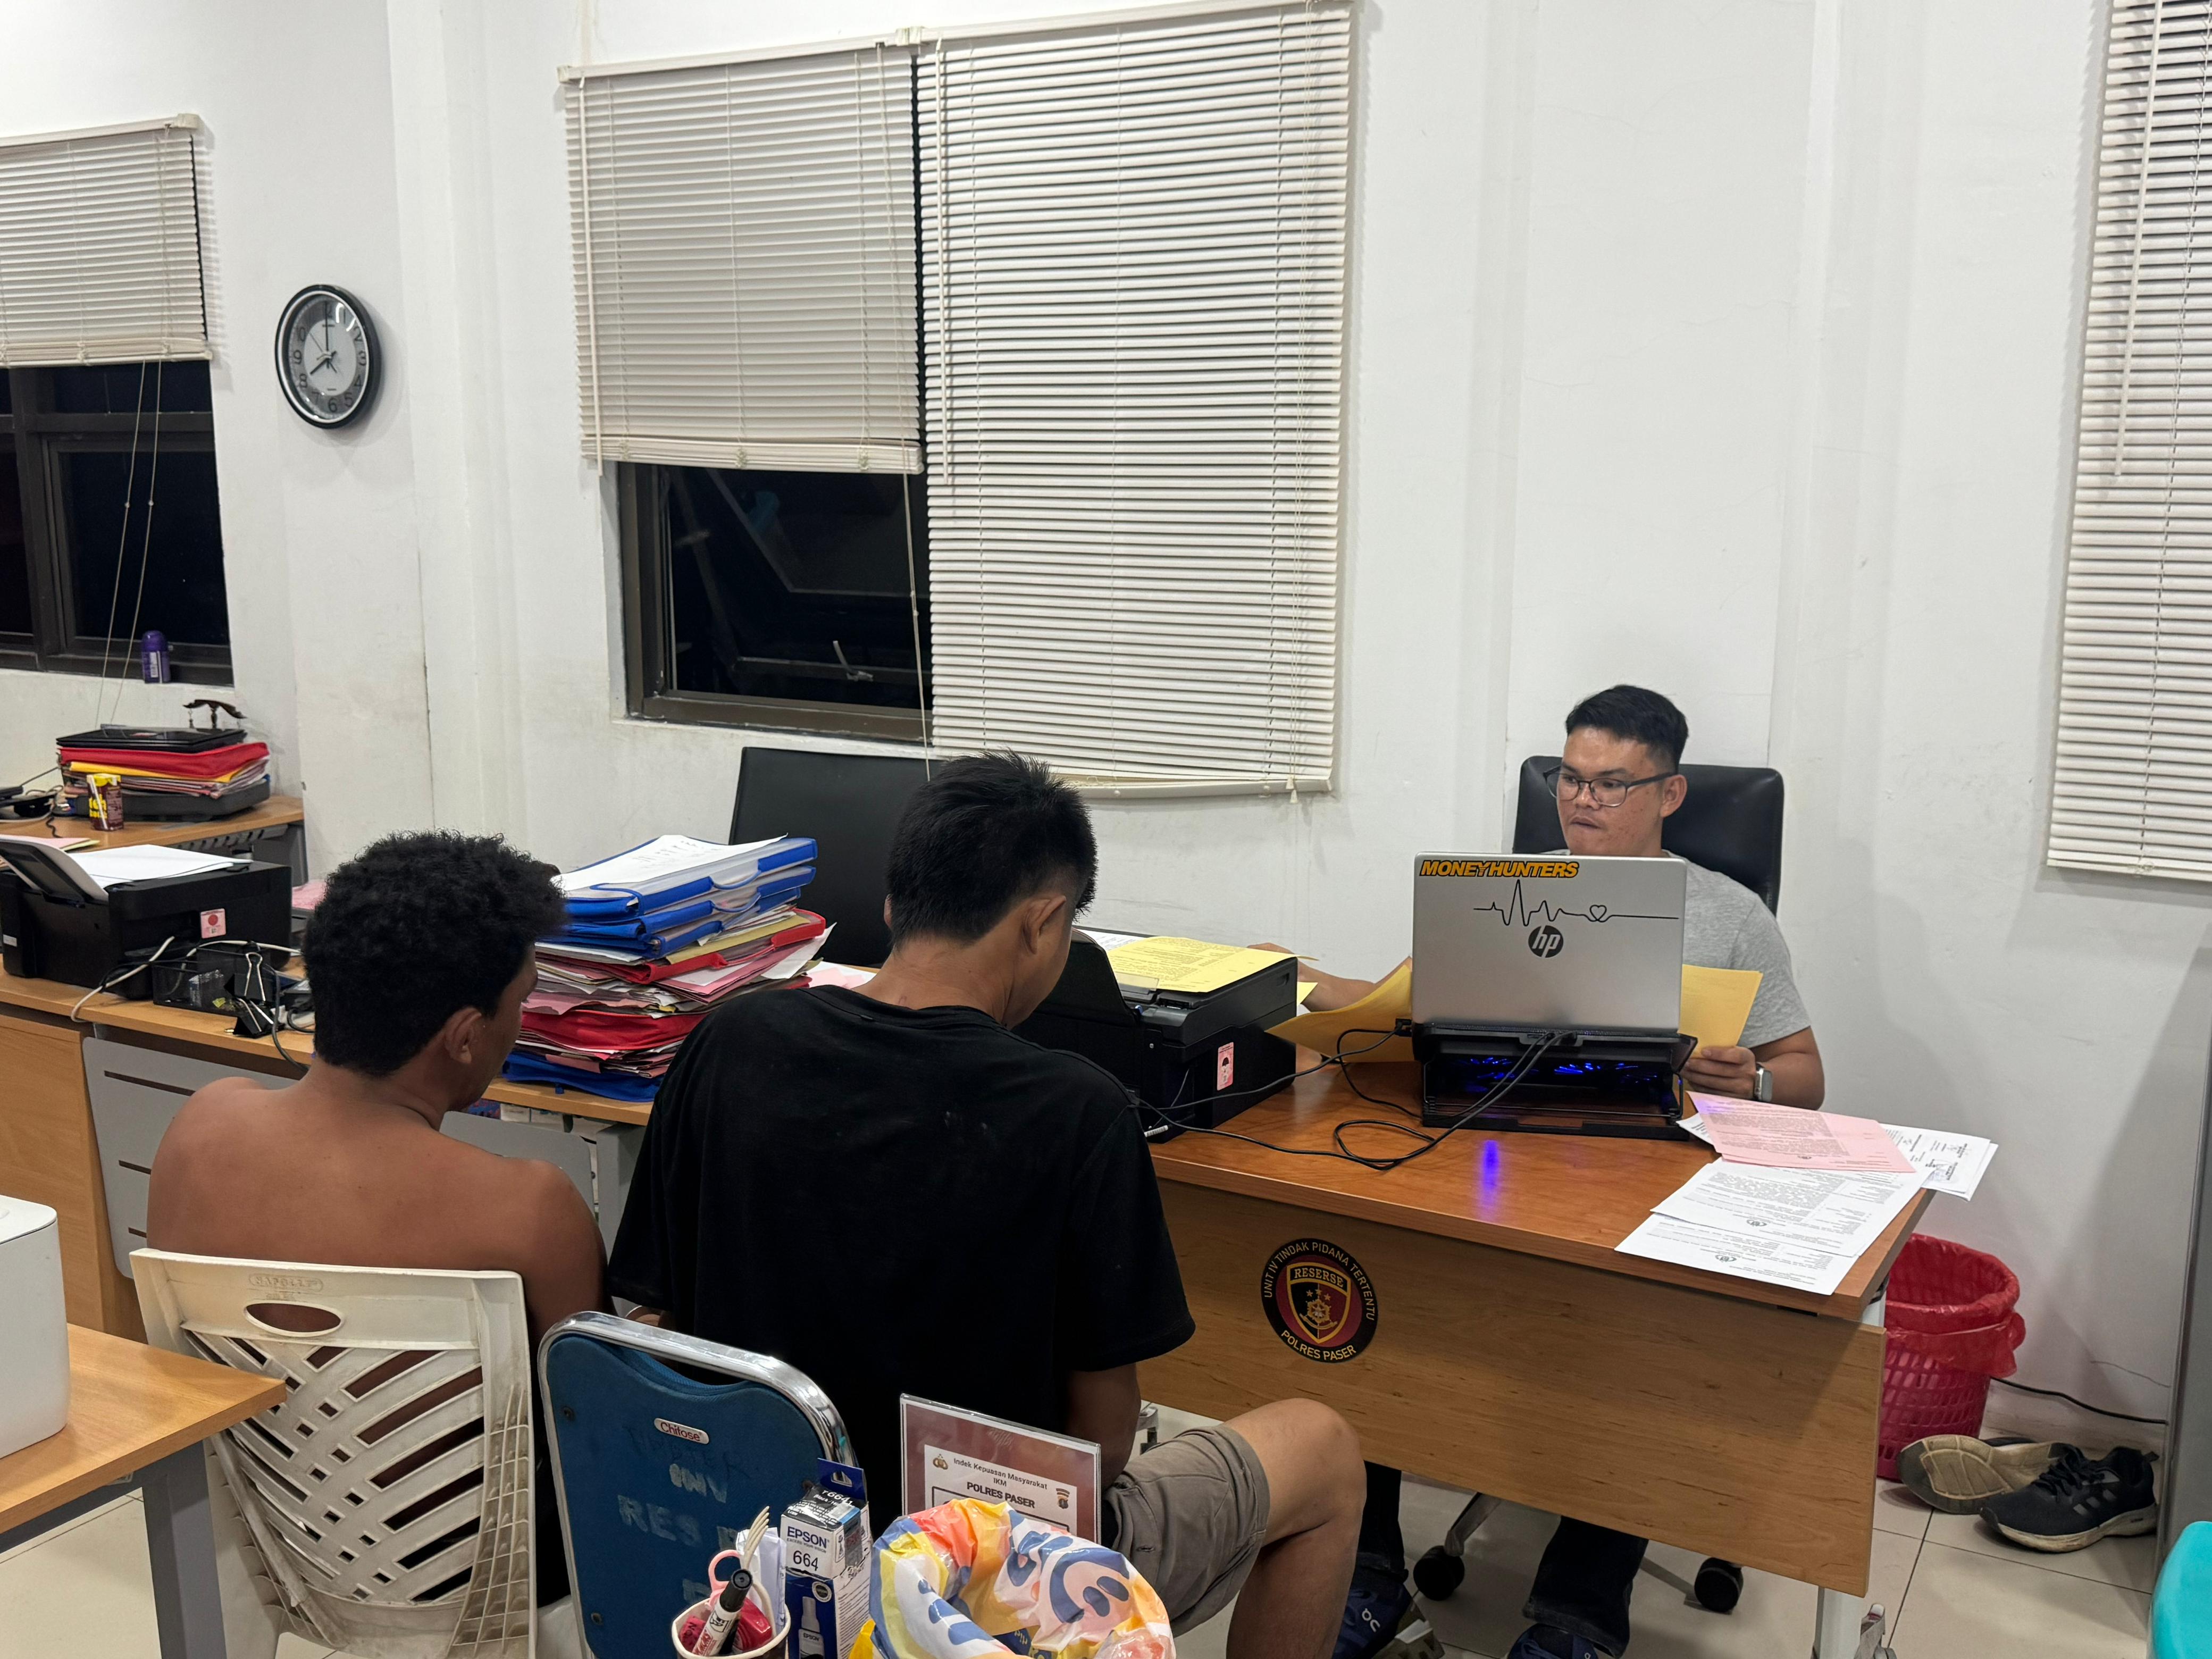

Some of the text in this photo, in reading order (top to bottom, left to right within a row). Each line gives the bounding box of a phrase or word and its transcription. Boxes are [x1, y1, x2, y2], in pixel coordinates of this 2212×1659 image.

[353, 327, 363, 342] 2
[293, 349, 303, 365] 9
[358, 351, 366, 366] 3
[298, 374, 308, 388] 8
[354, 374, 362, 388] 4
[312, 391, 321, 405] 7
[328, 397, 338, 413] 6
[343, 392, 354, 407] 5
[1420, 860, 1579, 877] MONEYHUNTERS
[1530, 926, 1562, 957] hp
[1264, 1242, 1375, 1321] UNIT IV TINDAK PIDANA TERTENTU
[1294, 1267, 1344, 1288] RESERSE
[1281, 1330, 1356, 1360] POLRES PASER
[660, 1422, 700, 1441] Chitose
[953, 1458, 1048, 1489] Indek Kepuasan Masyarakat
[993, 1478, 1007, 1487] IKM
[967, 1481, 1035, 1509] POLRES PASER
[787, 1526, 827, 1549] EPSON
[793, 1550, 818, 1571] 664
[803, 1633, 819, 1642] EPSON
